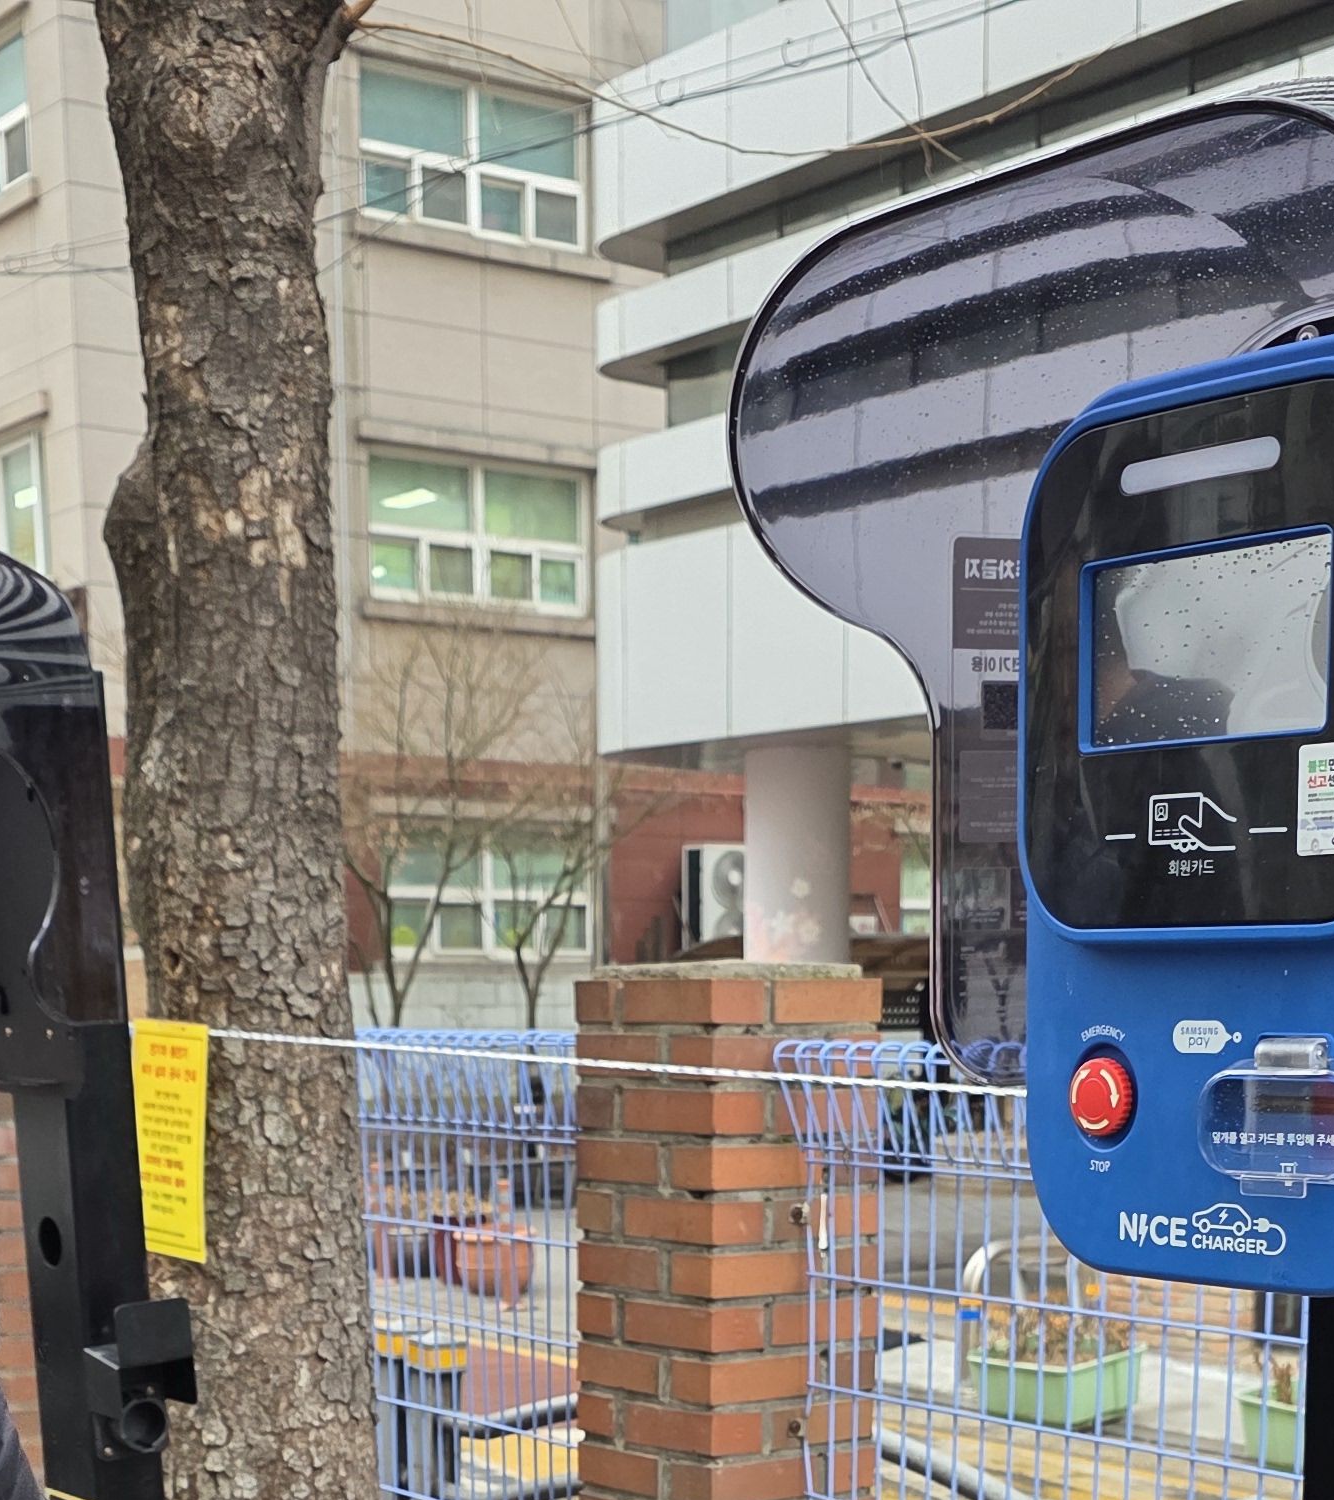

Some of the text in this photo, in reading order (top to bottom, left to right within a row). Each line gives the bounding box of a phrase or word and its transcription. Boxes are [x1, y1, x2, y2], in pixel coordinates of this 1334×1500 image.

[1167, 859, 1216, 877] 회원카드
[1080, 1025, 1126, 1042] EMERGENCY
[1180, 1026, 1219, 1036] SAMSUNG
[1188, 1036, 1211, 1048] pay
[1212, 1132, 1237, 1145] 덮개를
[1240, 1132, 1257, 1145] 열고
[1258, 1132, 1285, 1146] 카드를
[1286, 1132, 1314, 1146] 투입해
[1089, 1159, 1111, 1173] STOP
[1119, 1211, 1268, 1254] NICE CHARGER
